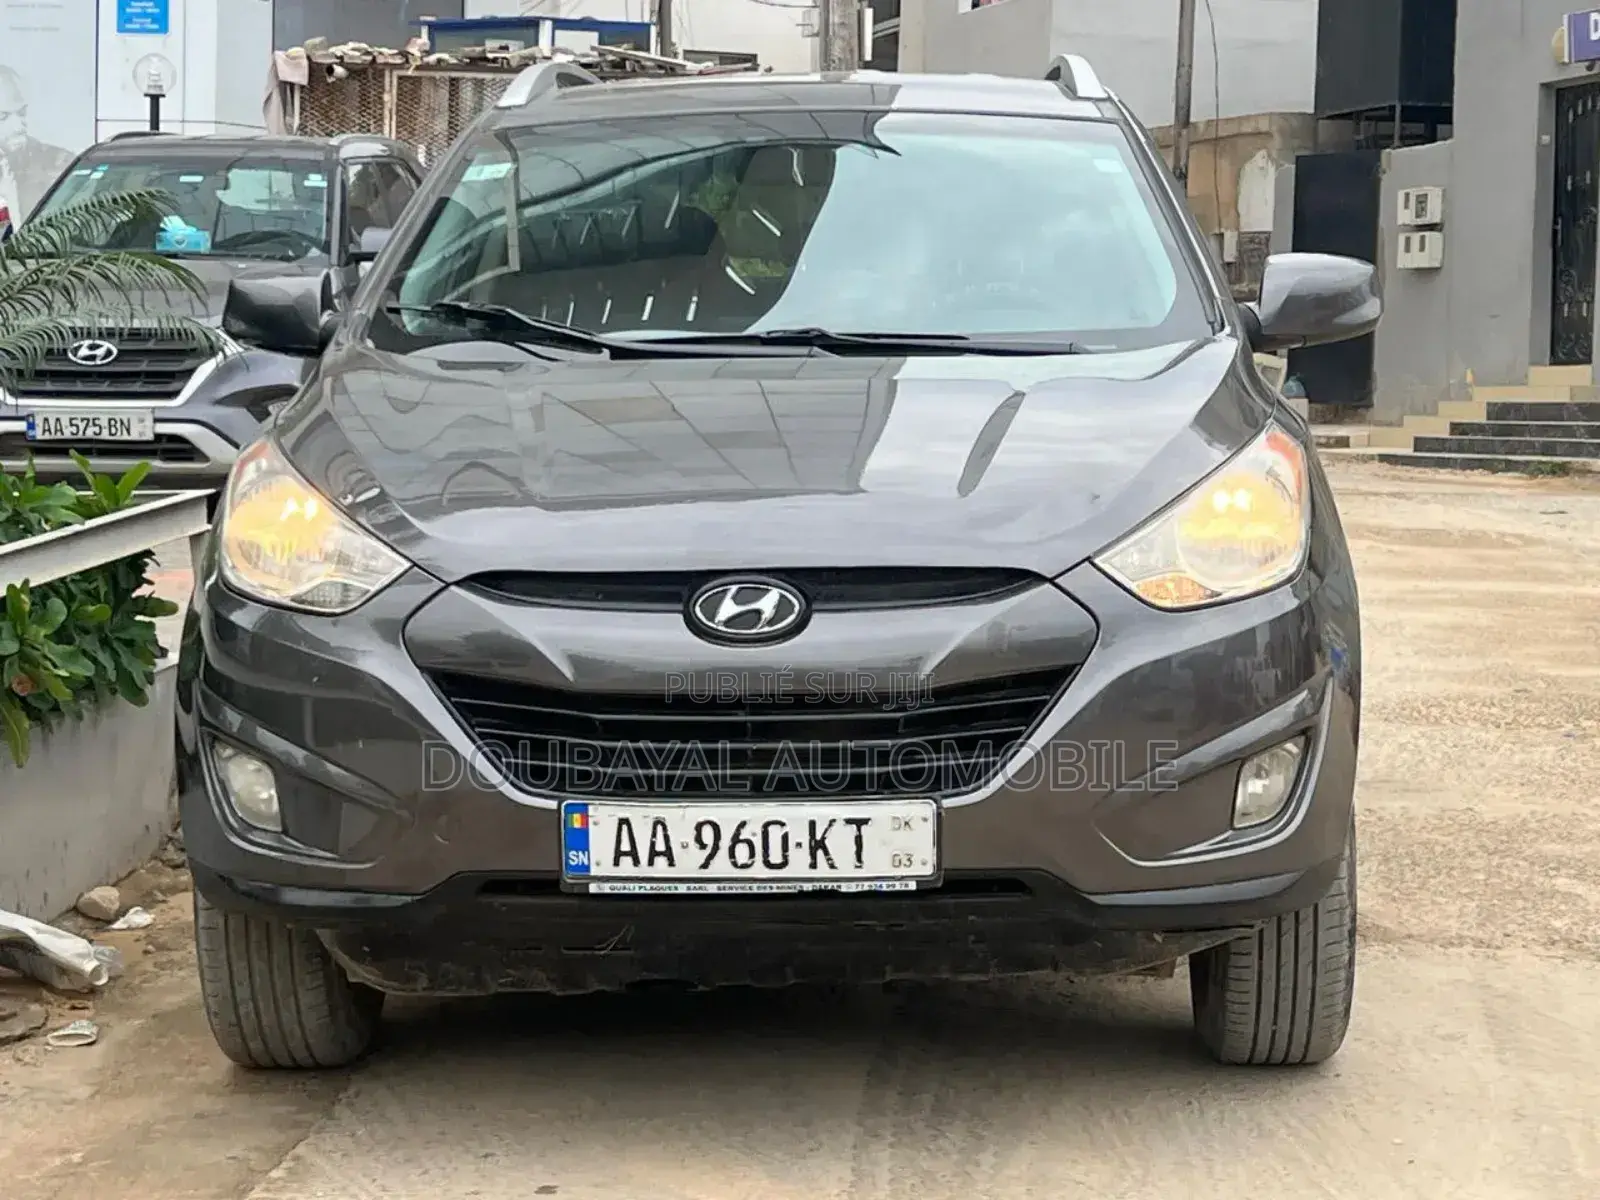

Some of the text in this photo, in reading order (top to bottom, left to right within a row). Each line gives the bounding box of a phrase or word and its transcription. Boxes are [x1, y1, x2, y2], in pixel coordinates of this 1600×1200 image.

[891, 815, 915, 832] DK
[568, 850, 590, 867] SN
[891, 852, 915, 868] 03
